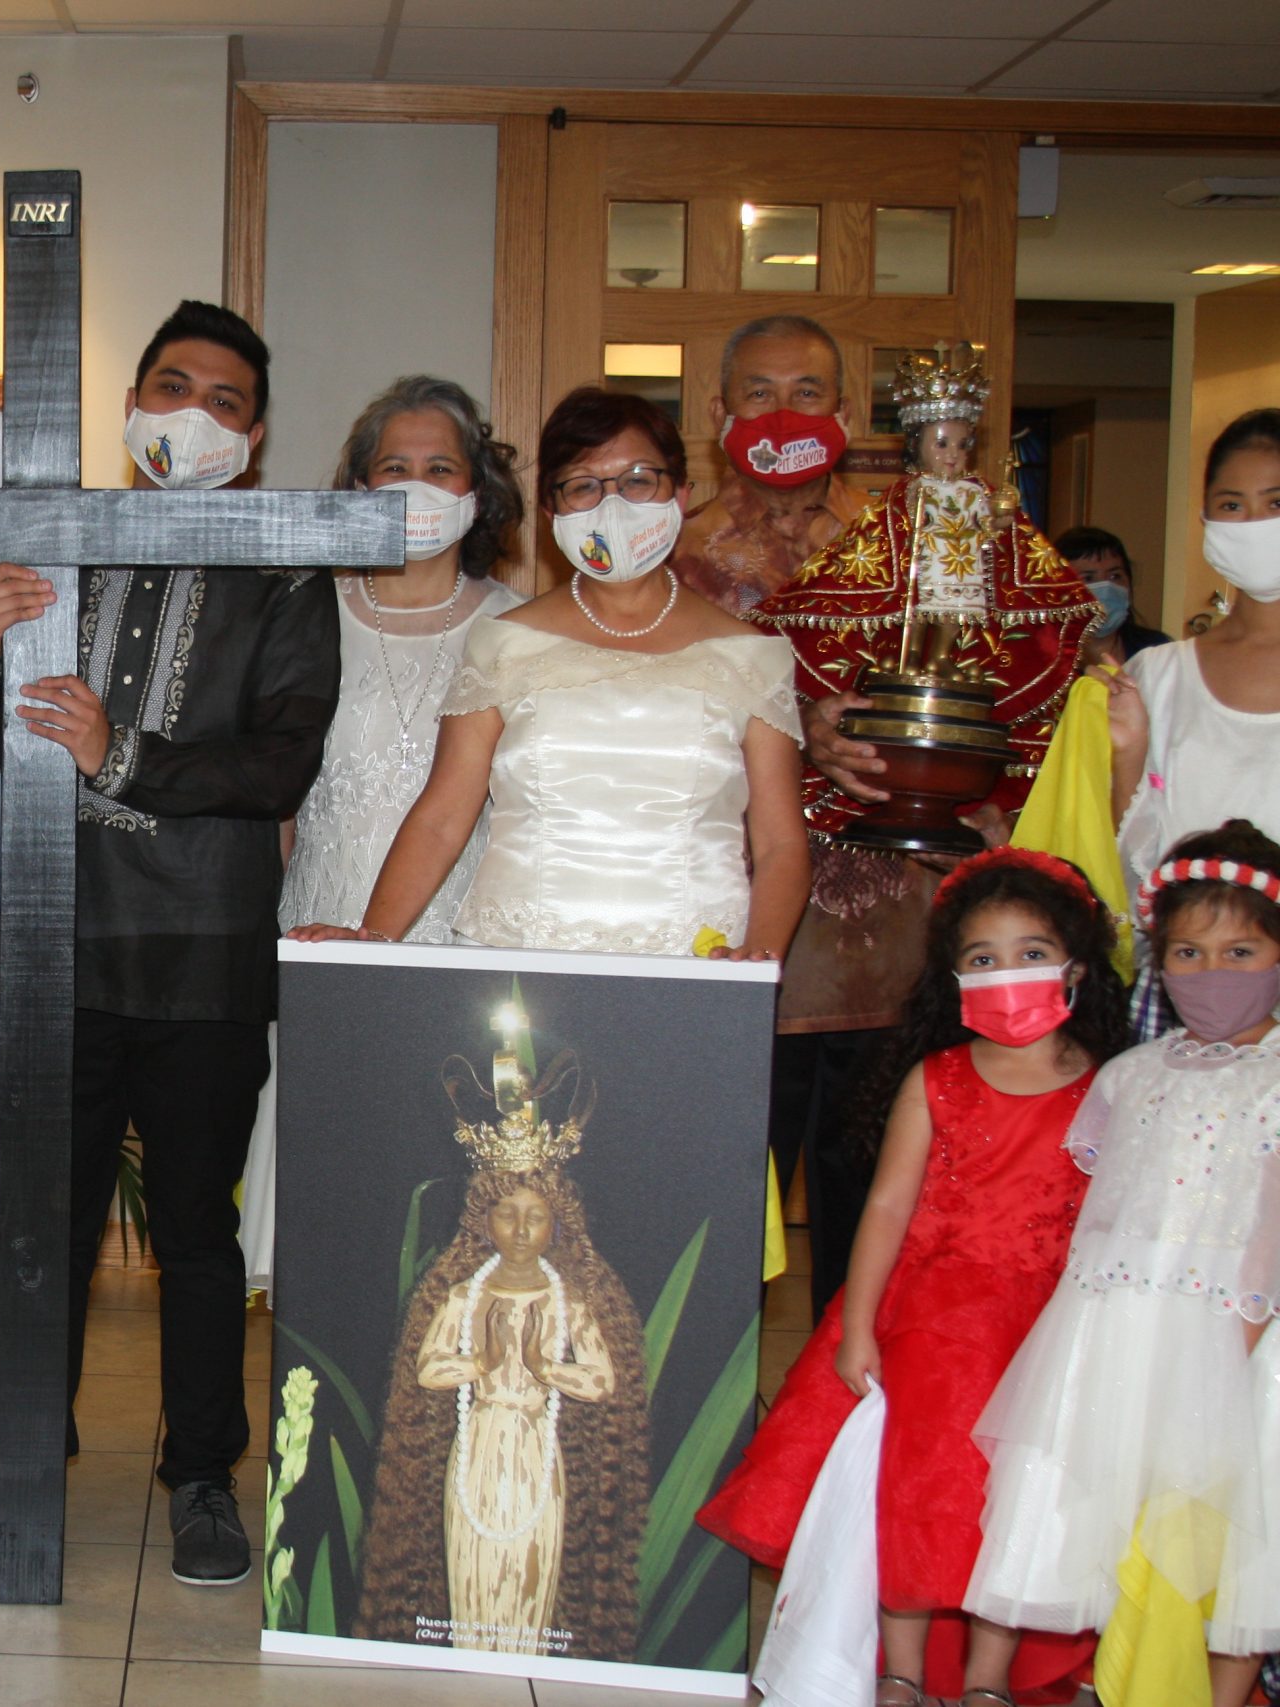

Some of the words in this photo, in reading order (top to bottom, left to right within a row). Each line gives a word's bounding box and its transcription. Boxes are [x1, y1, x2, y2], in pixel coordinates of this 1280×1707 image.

[10, 203, 70, 222] INRI
[783, 440, 817, 455] VIVA
[777, 456, 791, 472] PIT
[793, 449, 825, 470] SENYOR
[416, 1616, 468, 1630] Nuestra
[415, 1628, 444, 1641] (Our
[447, 1630, 479, 1644] Lady
[500, 1636, 568, 1652] Guidance)
